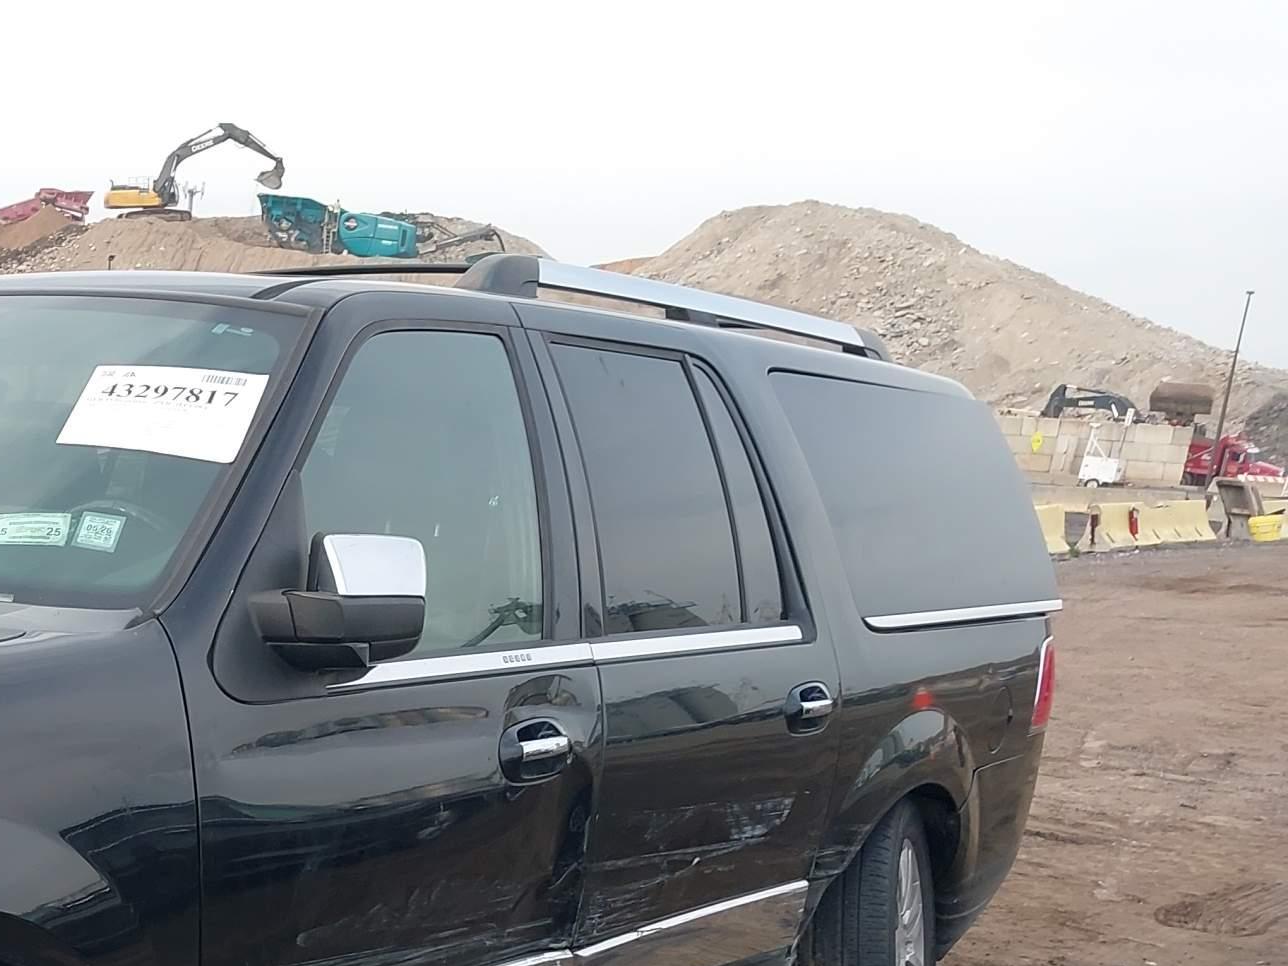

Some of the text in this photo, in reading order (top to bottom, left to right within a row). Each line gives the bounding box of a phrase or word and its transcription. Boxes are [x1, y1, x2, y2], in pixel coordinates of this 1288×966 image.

[101, 383, 239, 407] 43297817
[0, 527, 8, 536] 5
[46, 527, 61, 537] 25
